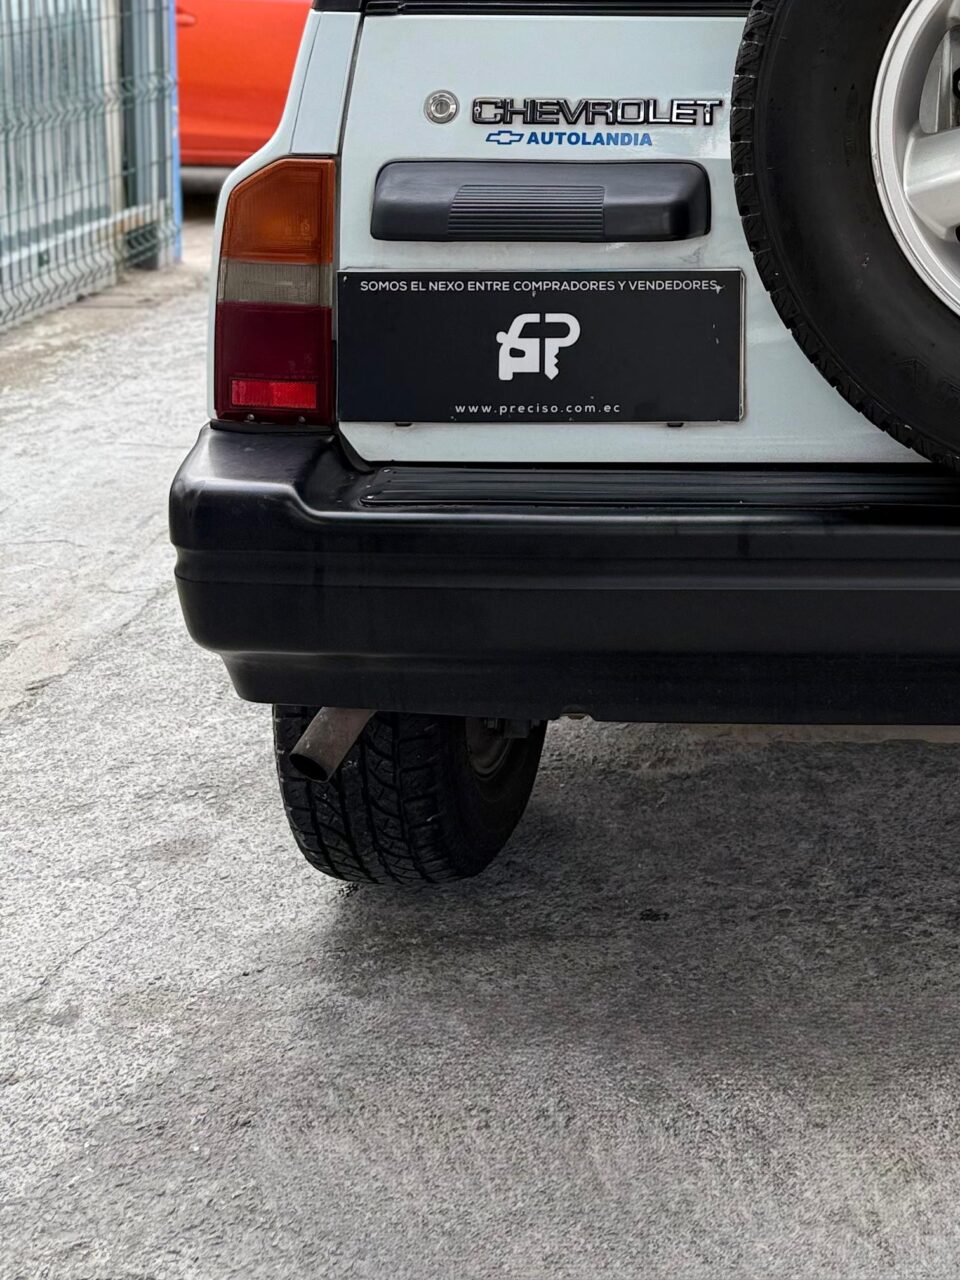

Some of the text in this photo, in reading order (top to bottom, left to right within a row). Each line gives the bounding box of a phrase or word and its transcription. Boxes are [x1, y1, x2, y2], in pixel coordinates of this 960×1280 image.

[472, 98, 722, 126] CHEVROLET
[526, 131, 653, 146] AUTOLANDIA
[360, 279, 719, 292] SOMOS EL NEXO ENTRE COMPRADORES Y VENDEDORES
[454, 402, 621, 416] www.preciso.com.ec
